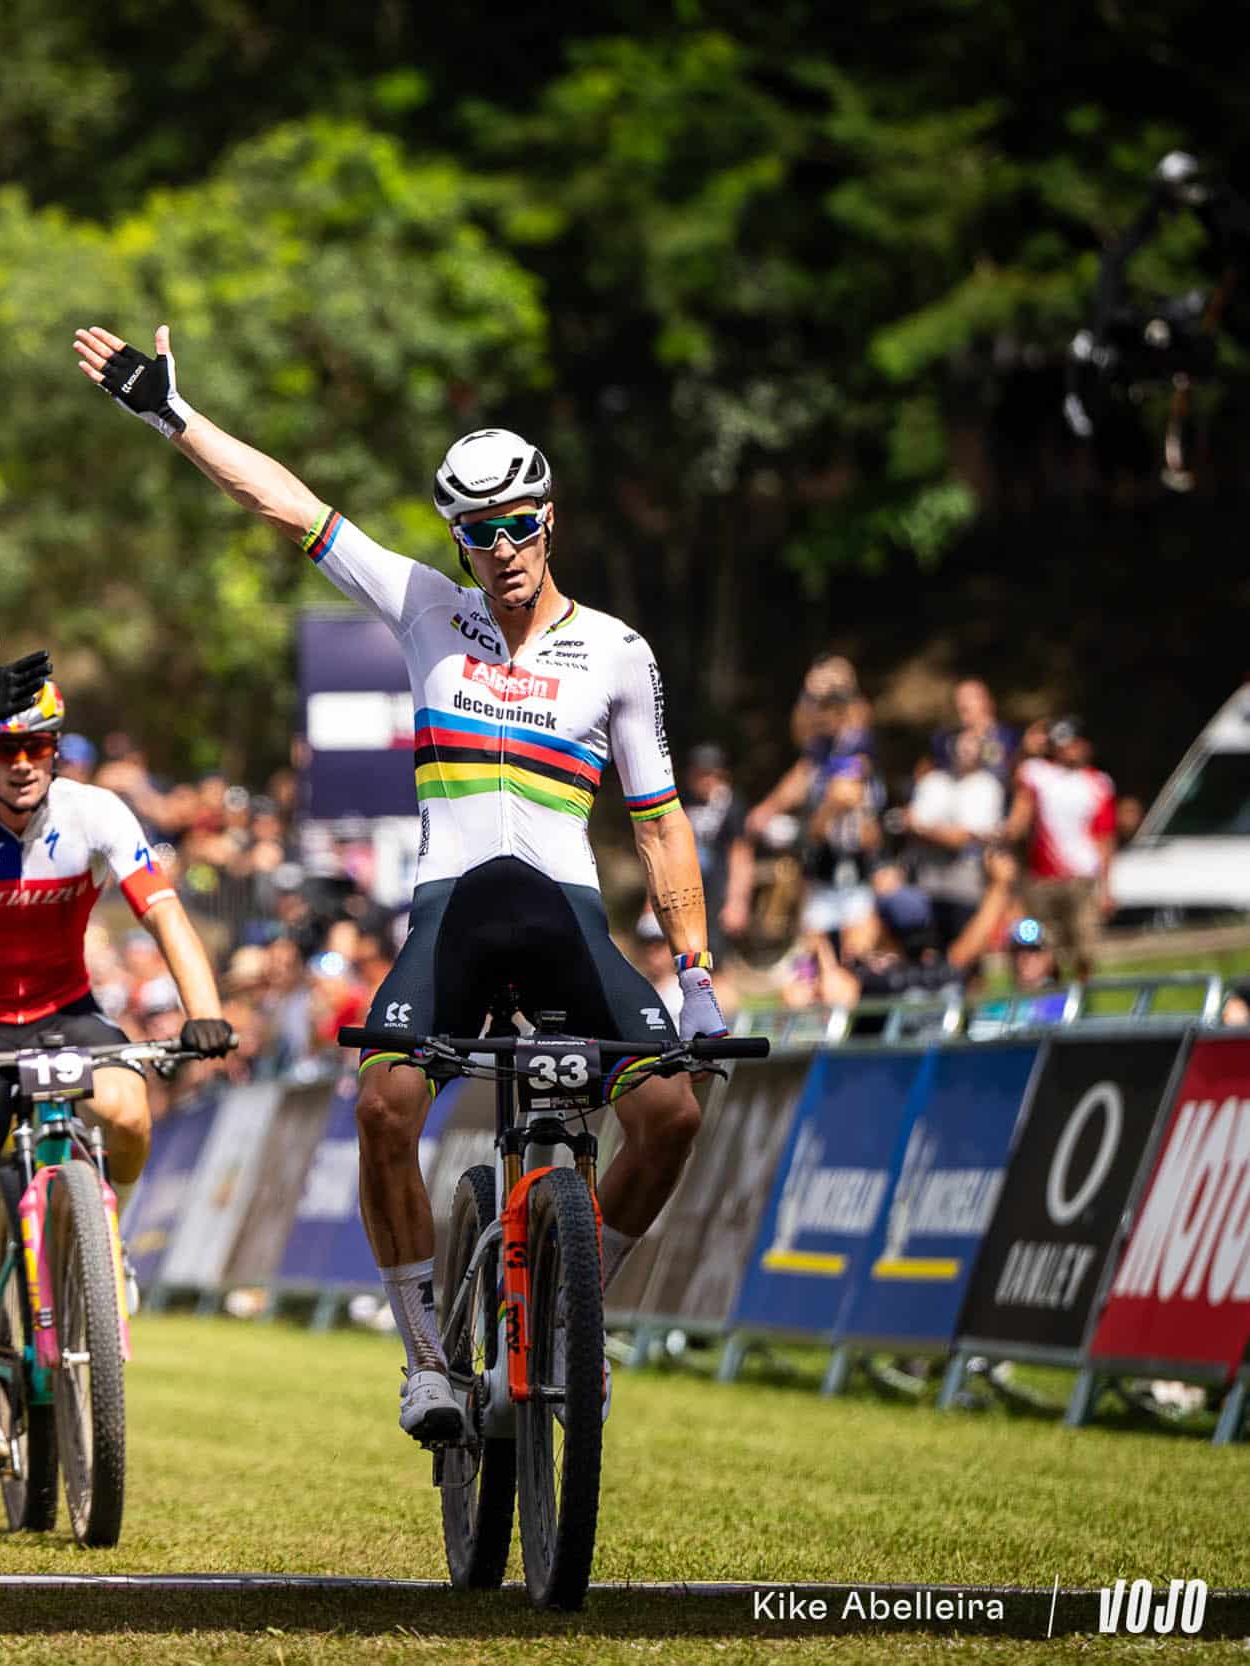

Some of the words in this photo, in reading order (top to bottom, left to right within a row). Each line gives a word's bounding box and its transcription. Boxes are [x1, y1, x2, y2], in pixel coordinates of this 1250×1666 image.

[460, 620, 502, 657] UCI
[472, 663, 548, 697] Alpecin
[453, 690, 558, 731] deceuninck
[27, 1051, 86, 1085] 19
[528, 1054, 589, 1090] 33
